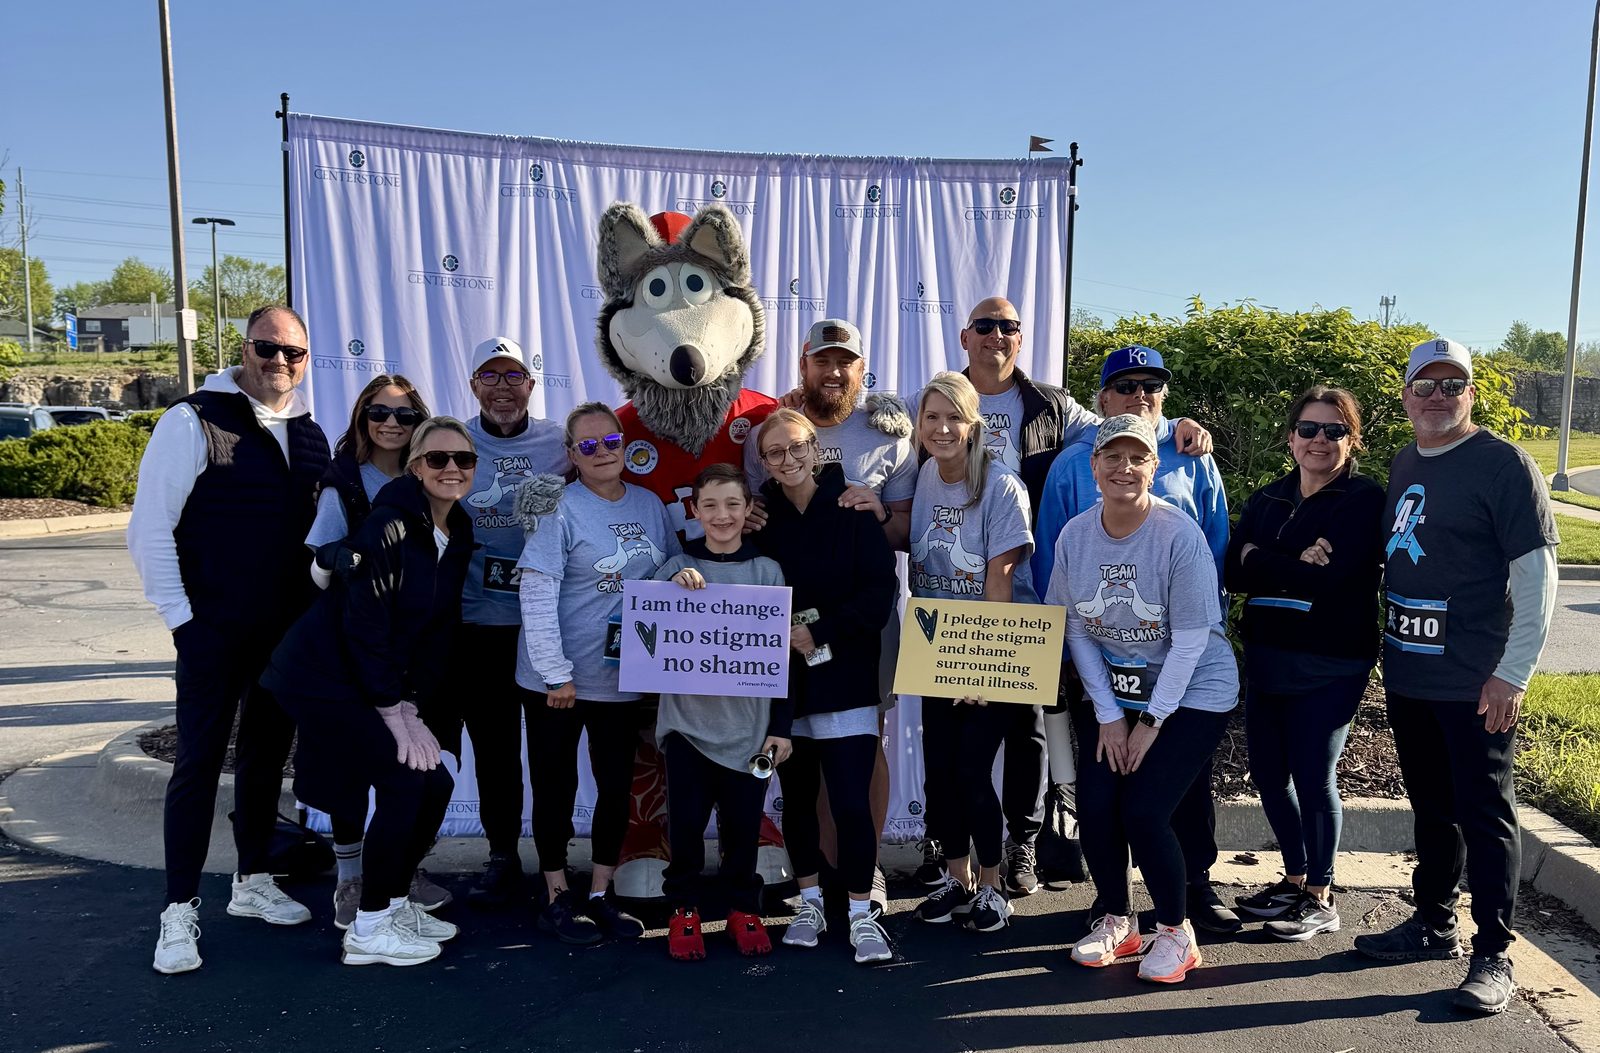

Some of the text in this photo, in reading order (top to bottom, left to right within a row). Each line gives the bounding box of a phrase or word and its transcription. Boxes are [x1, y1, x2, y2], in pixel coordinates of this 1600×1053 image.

[314, 168, 400, 188] CENTERSTONE
[964, 207, 1046, 221] CENTERSTONE
[407, 273, 495, 291] CENTERSTONE
[313, 357, 400, 375] CENTERSTONE
[1128, 348, 1147, 366] KC
[493, 456, 533, 472] TEAM
[933, 506, 964, 525] TEAM
[608, 522, 646, 536] TEAM
[1099, 564, 1137, 580] TEAM
[630, 595, 785, 620] I am the change.
[942, 613, 1052, 632] I pledge to help
[1399, 614, 1439, 638] 210
[663, 626, 783, 651] no stigma
[941, 629, 1046, 646] end the stigma
[1119, 624, 1168, 642] BUMPS
[938, 643, 1017, 658] and shame
[663, 655, 780, 676] no shame
[936, 660, 1031, 677] surrounding
[934, 674, 1038, 691] mental illness.
